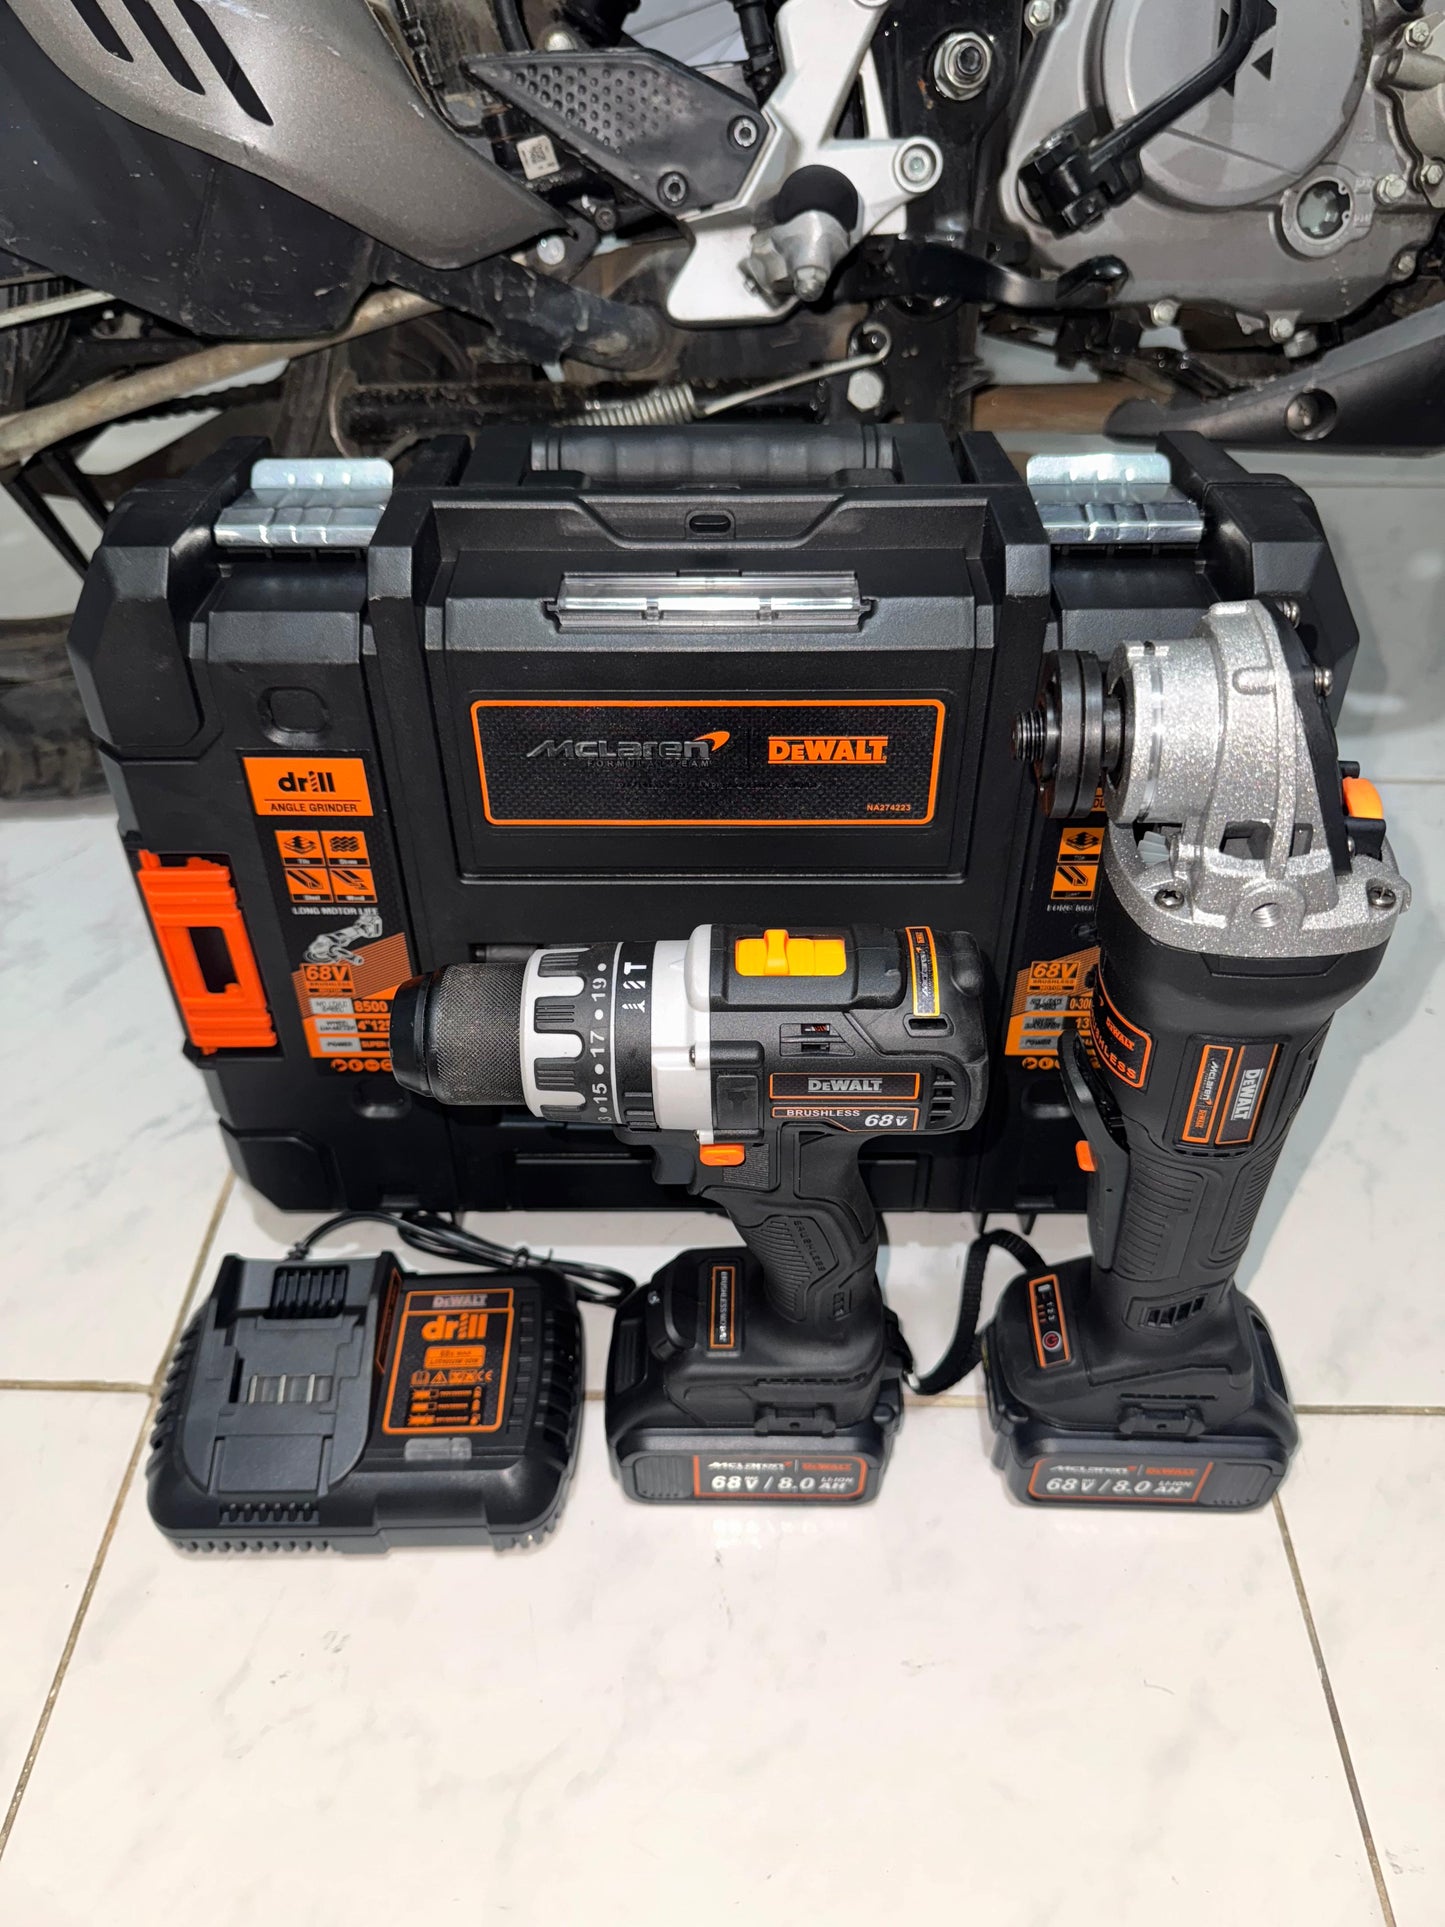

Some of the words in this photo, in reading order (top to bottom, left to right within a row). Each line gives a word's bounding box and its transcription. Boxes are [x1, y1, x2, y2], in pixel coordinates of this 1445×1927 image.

[526, 739, 711, 758] McLaren
[768, 736, 888, 764] DEWALT
[277, 770, 336, 793] drill
[271, 803, 306, 813] ANGLE
[309, 803, 359, 813] GRINDER
[866, 803, 912, 812] NA274223
[306, 966, 348, 981] 68V
[1032, 963, 1078, 978] 68V
[591, 979, 607, 1002] 19
[353, 1000, 389, 1013] 8500
[590, 1030, 605, 1058] 17
[807, 1077, 883, 1093] DEWALT
[591, 1083, 608, 1104] 15
[1230, 1068, 1265, 1121] DEWALT
[786, 1109, 861, 1117] BRUSHLESS
[421, 1312, 489, 1342] drill
[777, 1476, 816, 1491] 8.0
[1112, 1479, 1152, 1494] 8.0
